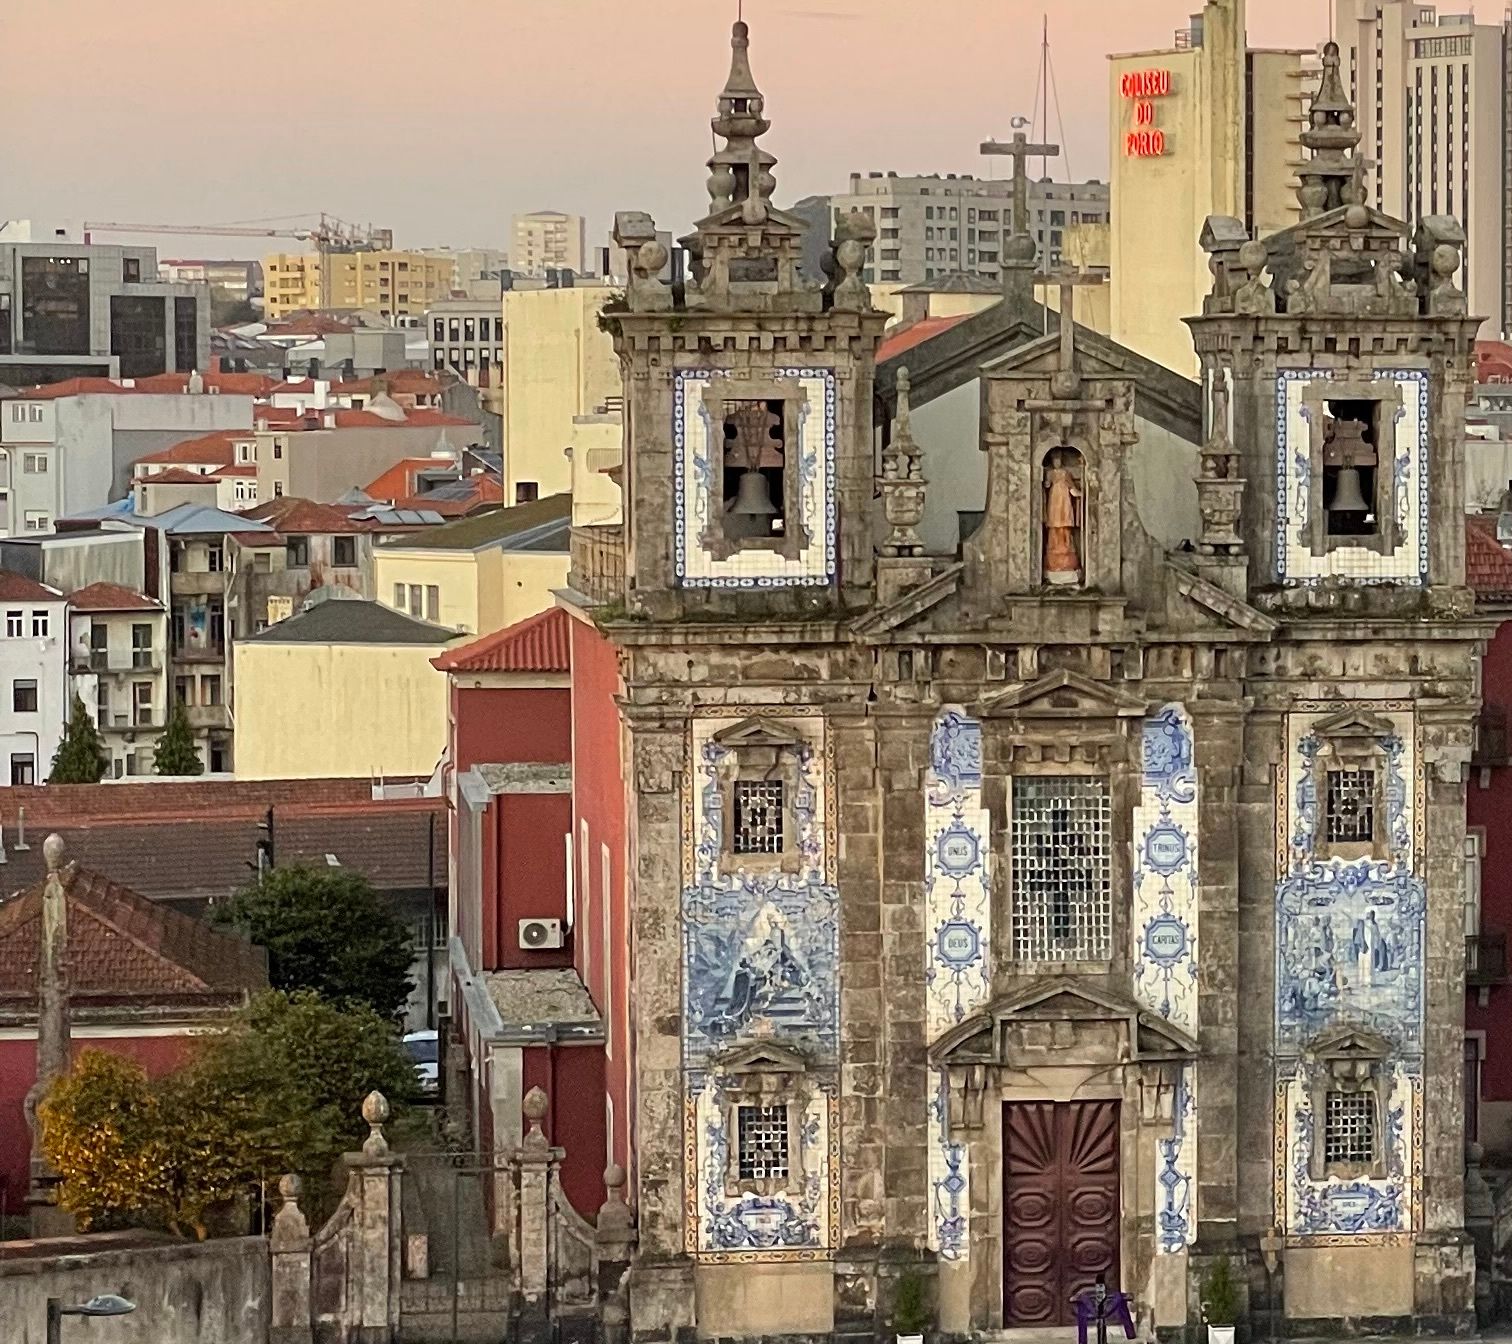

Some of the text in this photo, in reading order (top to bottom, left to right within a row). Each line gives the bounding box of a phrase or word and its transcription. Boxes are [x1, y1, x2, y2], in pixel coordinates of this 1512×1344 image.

[1120, 70, 1169, 96] COLISEU
[1135, 102, 1153, 124] DO
[1126, 131, 1164, 156] PORTO
